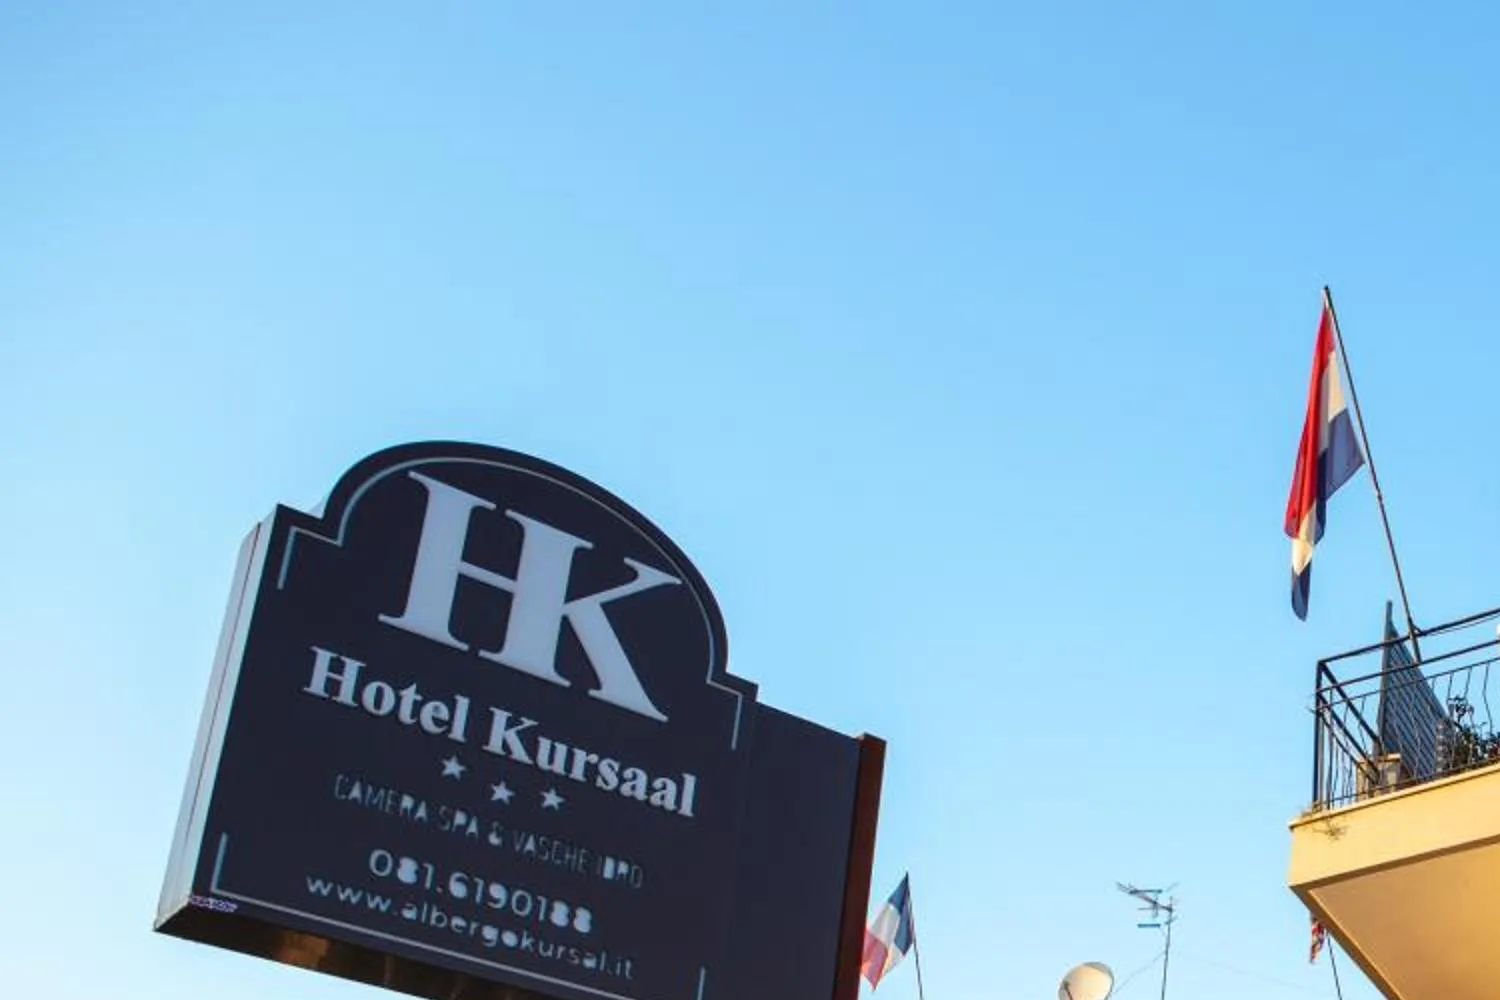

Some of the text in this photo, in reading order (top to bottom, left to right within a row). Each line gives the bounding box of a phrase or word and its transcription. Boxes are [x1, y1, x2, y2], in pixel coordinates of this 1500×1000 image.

[378, 471, 683, 723] HK
[303, 646, 698, 818] Hotel Kursaal
[334, 773, 429, 823] CAMERA
[438, 806, 480, 838] SPA
[305, 875, 635, 980] www.albergokursal.it
[368, 849, 593, 934] 081.6190188
